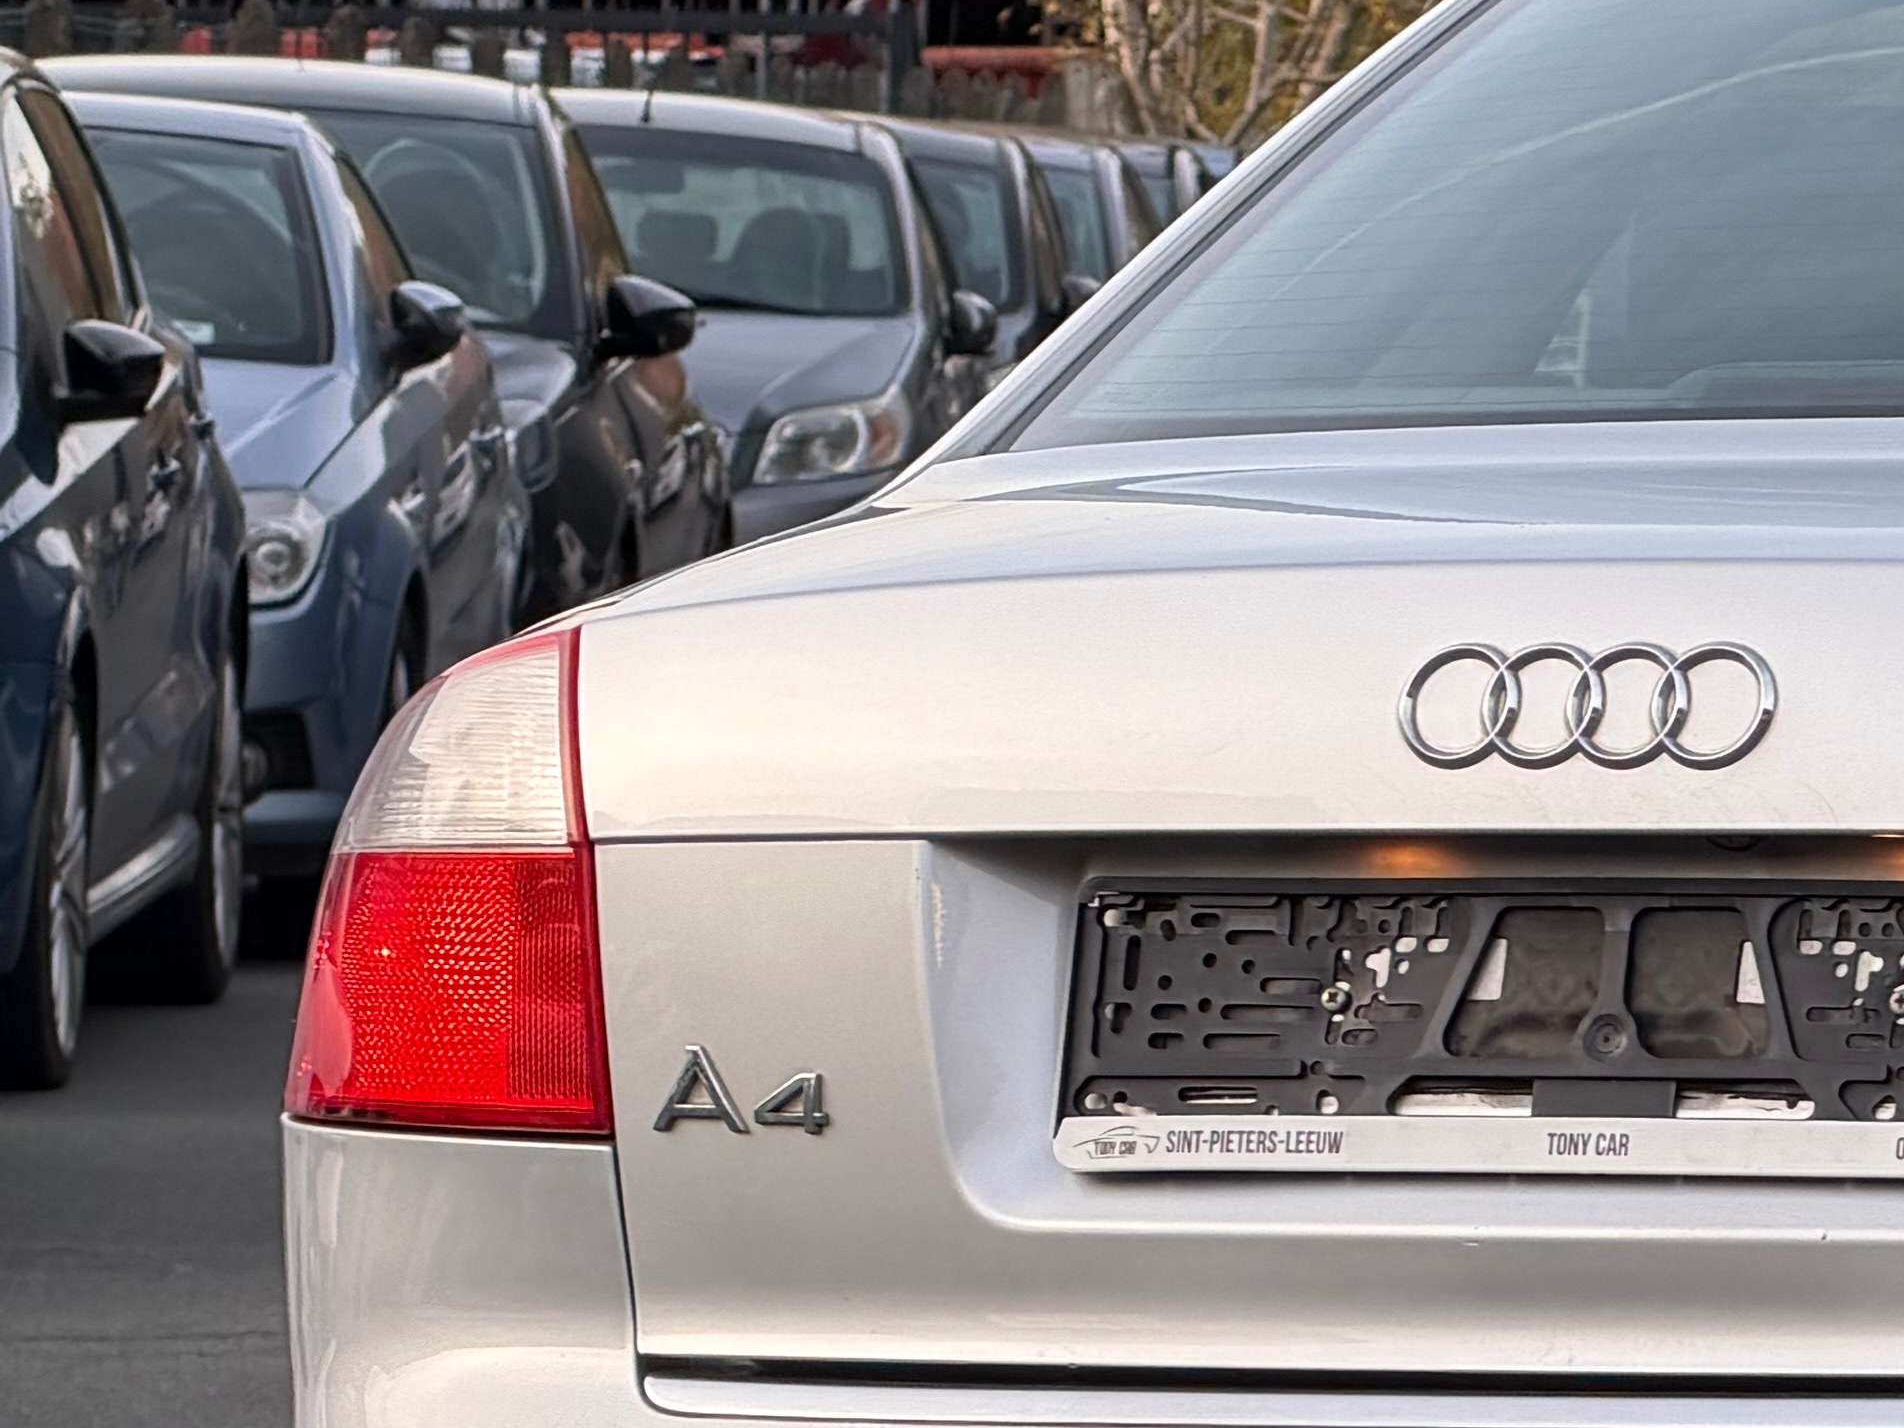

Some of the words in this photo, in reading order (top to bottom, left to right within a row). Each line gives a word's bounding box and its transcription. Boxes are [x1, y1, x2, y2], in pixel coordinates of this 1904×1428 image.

[653, 1044, 830, 1135] A4
[1165, 1129, 1343, 1155] SINT-PIETERS-LEEUW
[1547, 1132, 1592, 1156] TONY
[1595, 1132, 1630, 1157] CAR
